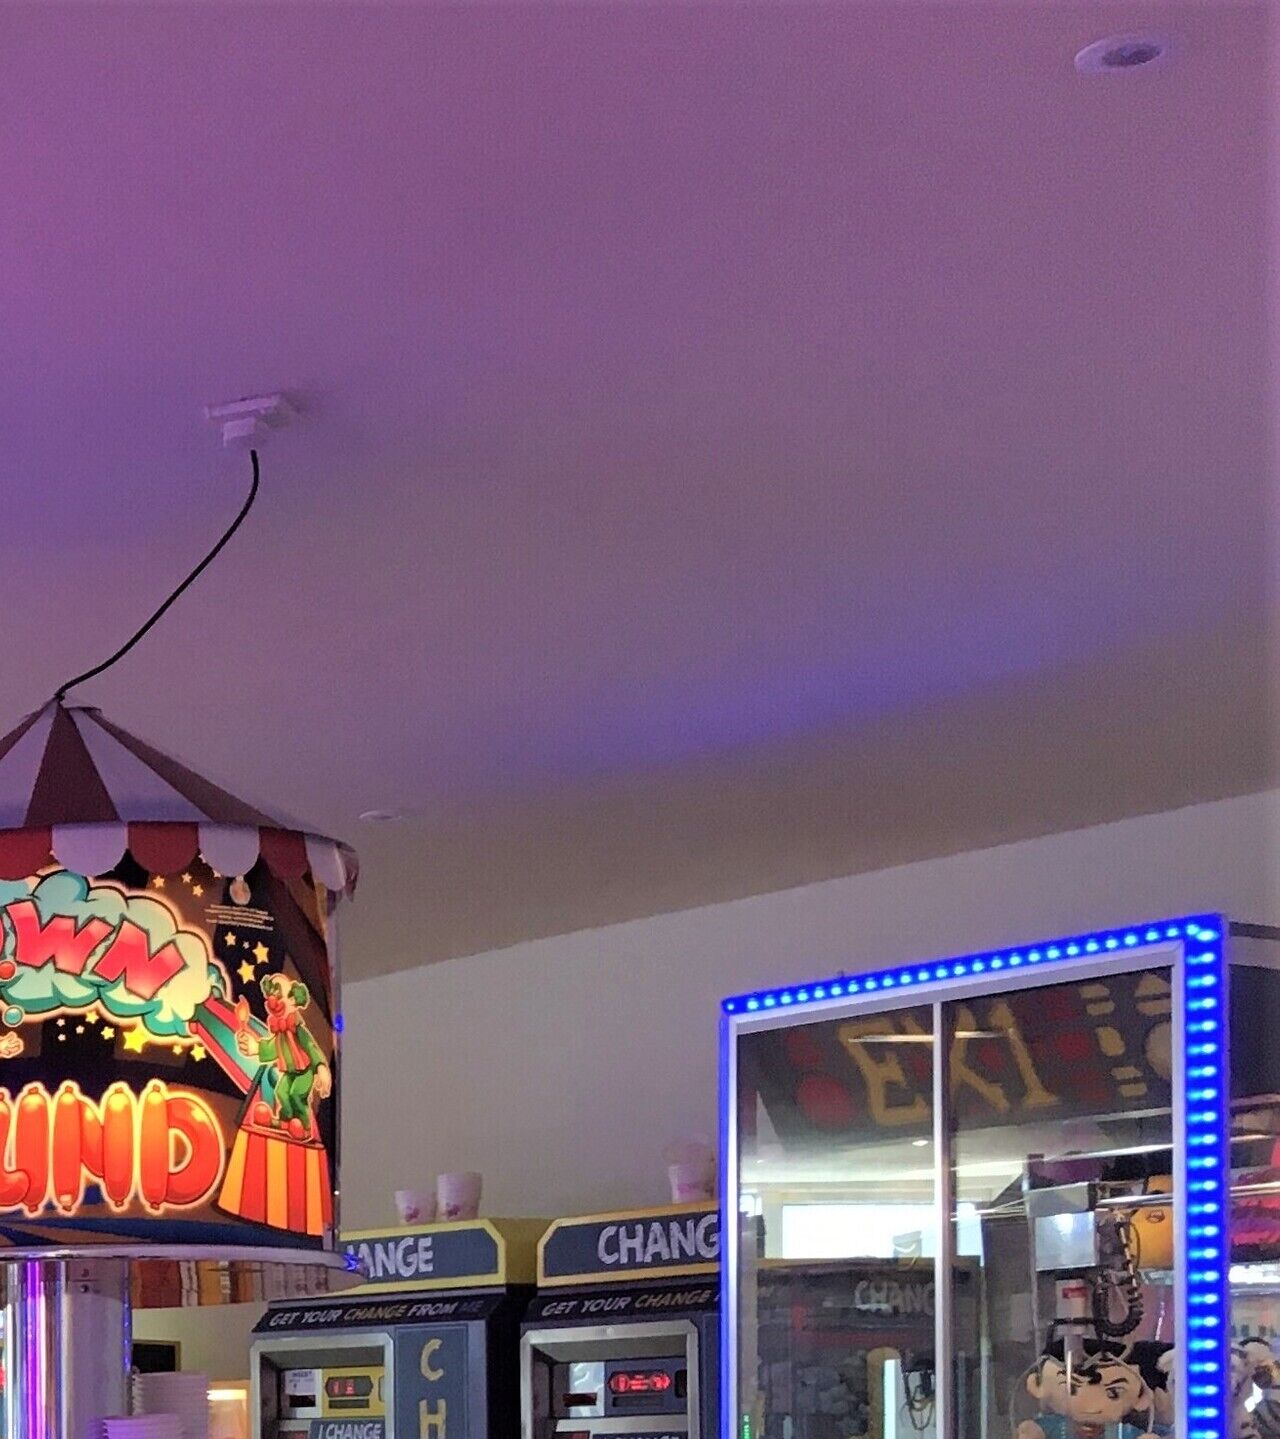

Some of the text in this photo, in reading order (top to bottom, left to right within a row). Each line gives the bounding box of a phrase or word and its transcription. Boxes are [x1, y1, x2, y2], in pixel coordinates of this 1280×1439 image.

[598, 1214, 721, 1265] CHANG
[347, 1237, 434, 1278] ANGE
[270, 1311, 296, 1327] GET
[301, 1309, 342, 1323] YOUR
[344, 1305, 407, 1321] CHANGE
[407, 1302, 459, 1317] FROM
[542, 1289, 712, 1316] GET YOUR CHANGE
